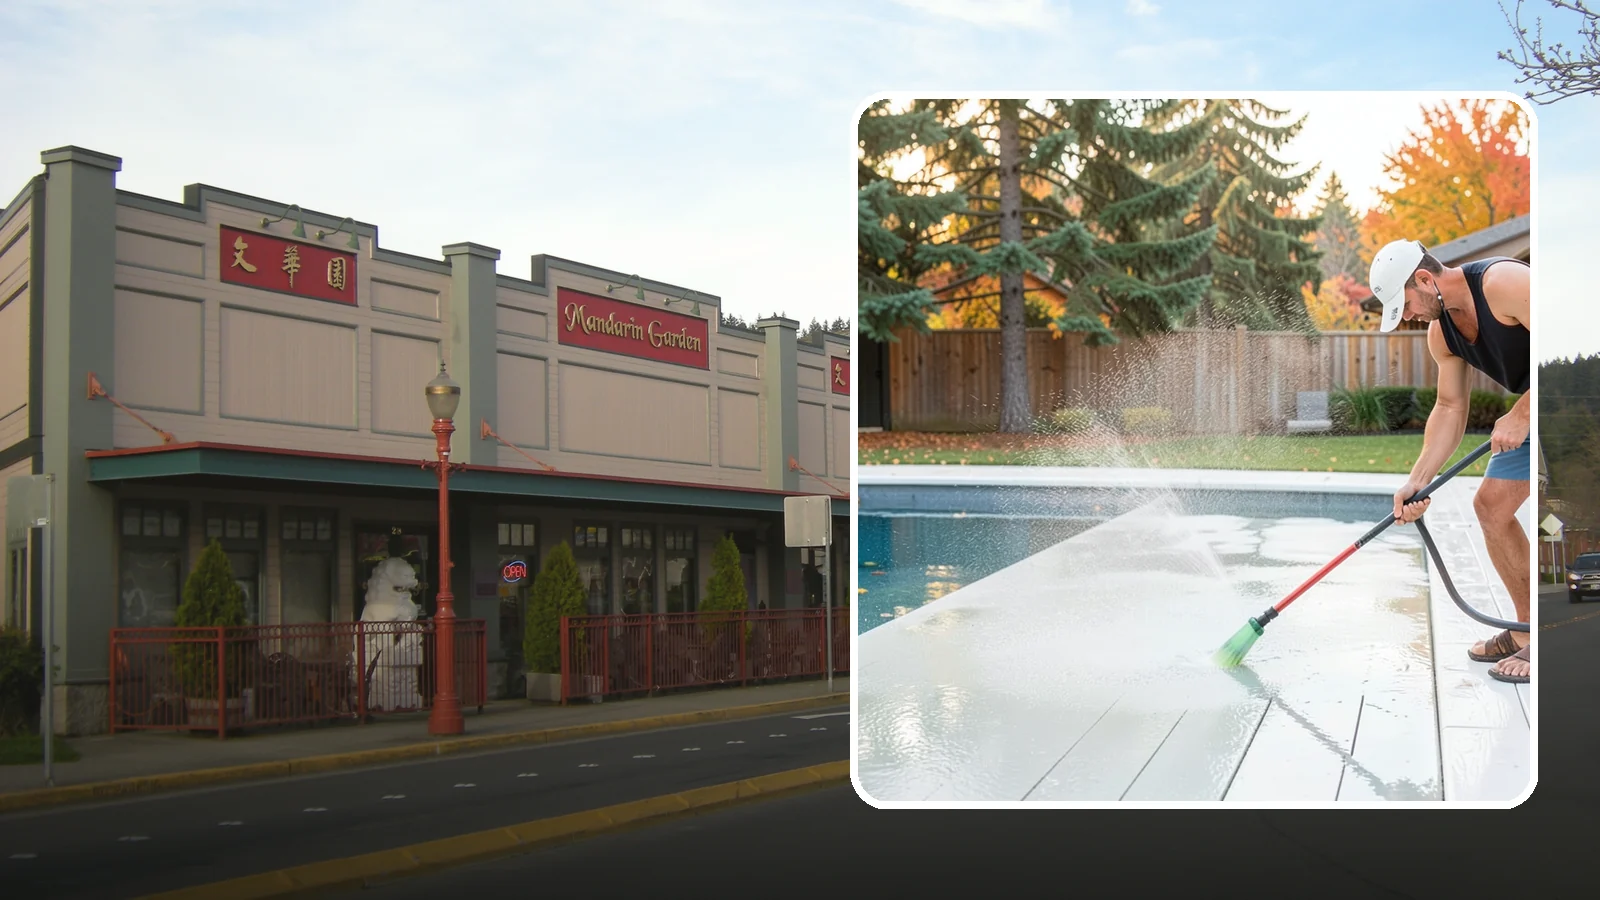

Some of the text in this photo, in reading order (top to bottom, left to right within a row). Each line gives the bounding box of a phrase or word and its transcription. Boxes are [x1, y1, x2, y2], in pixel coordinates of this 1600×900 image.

[564, 302, 701, 352] Mandarin Garden
[503, 565, 527, 578] OPEN
